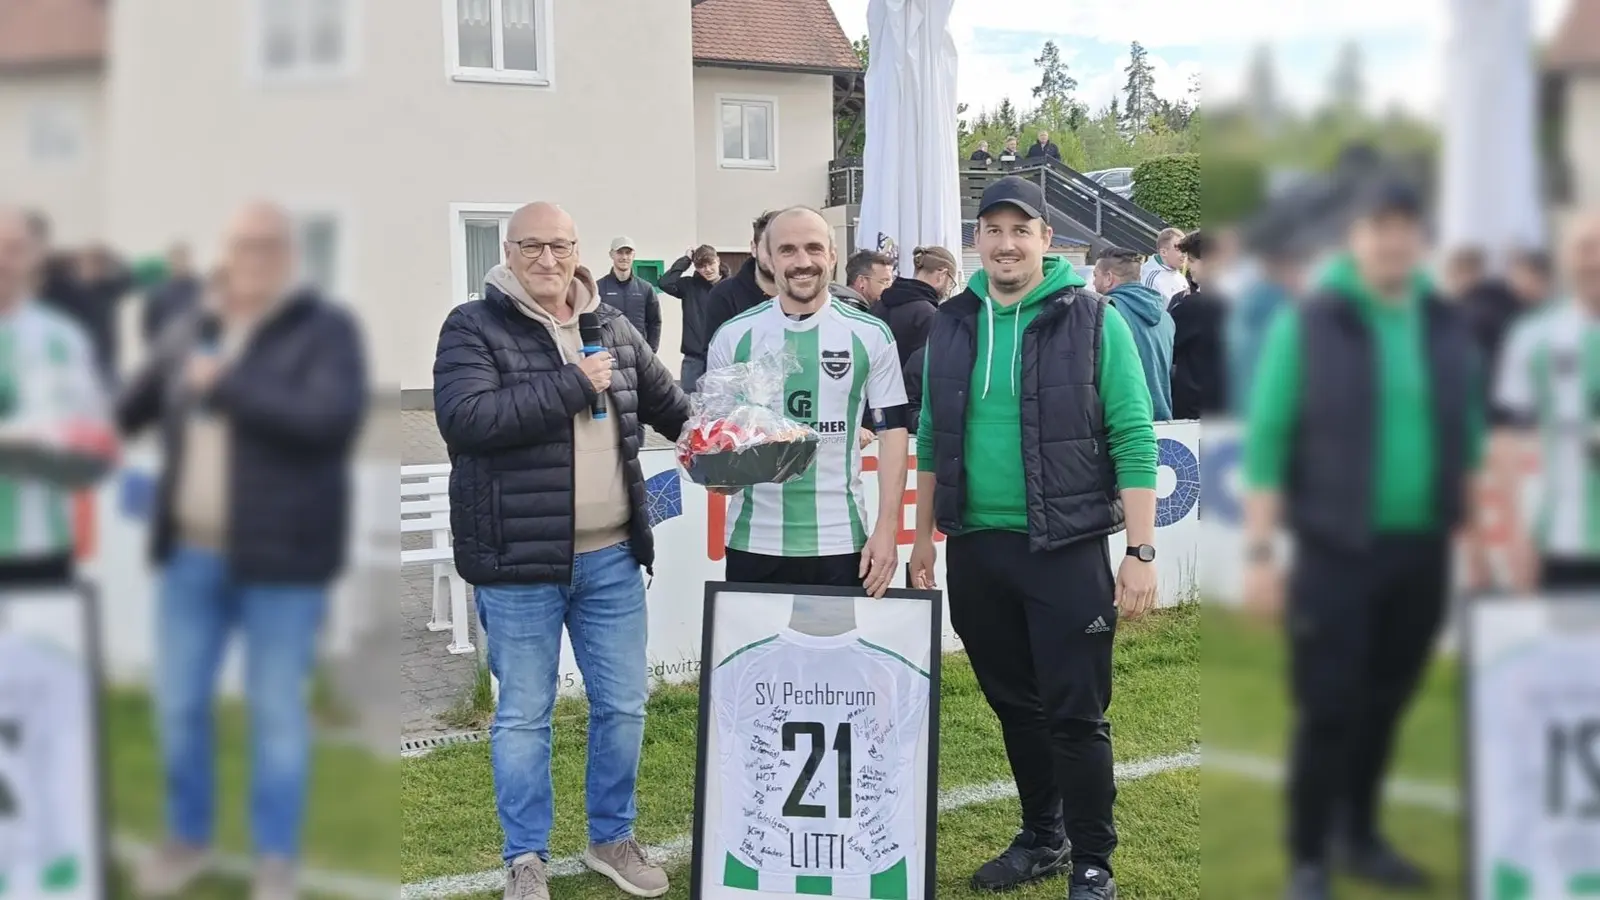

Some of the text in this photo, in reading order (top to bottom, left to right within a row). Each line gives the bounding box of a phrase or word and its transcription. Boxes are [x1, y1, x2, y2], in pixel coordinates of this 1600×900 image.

[755, 682, 876, 706] SV Pechbrunn
[755, 772, 777, 781] HOT
[782, 722, 852, 818] 21
[790, 832, 844, 869] LITTI
